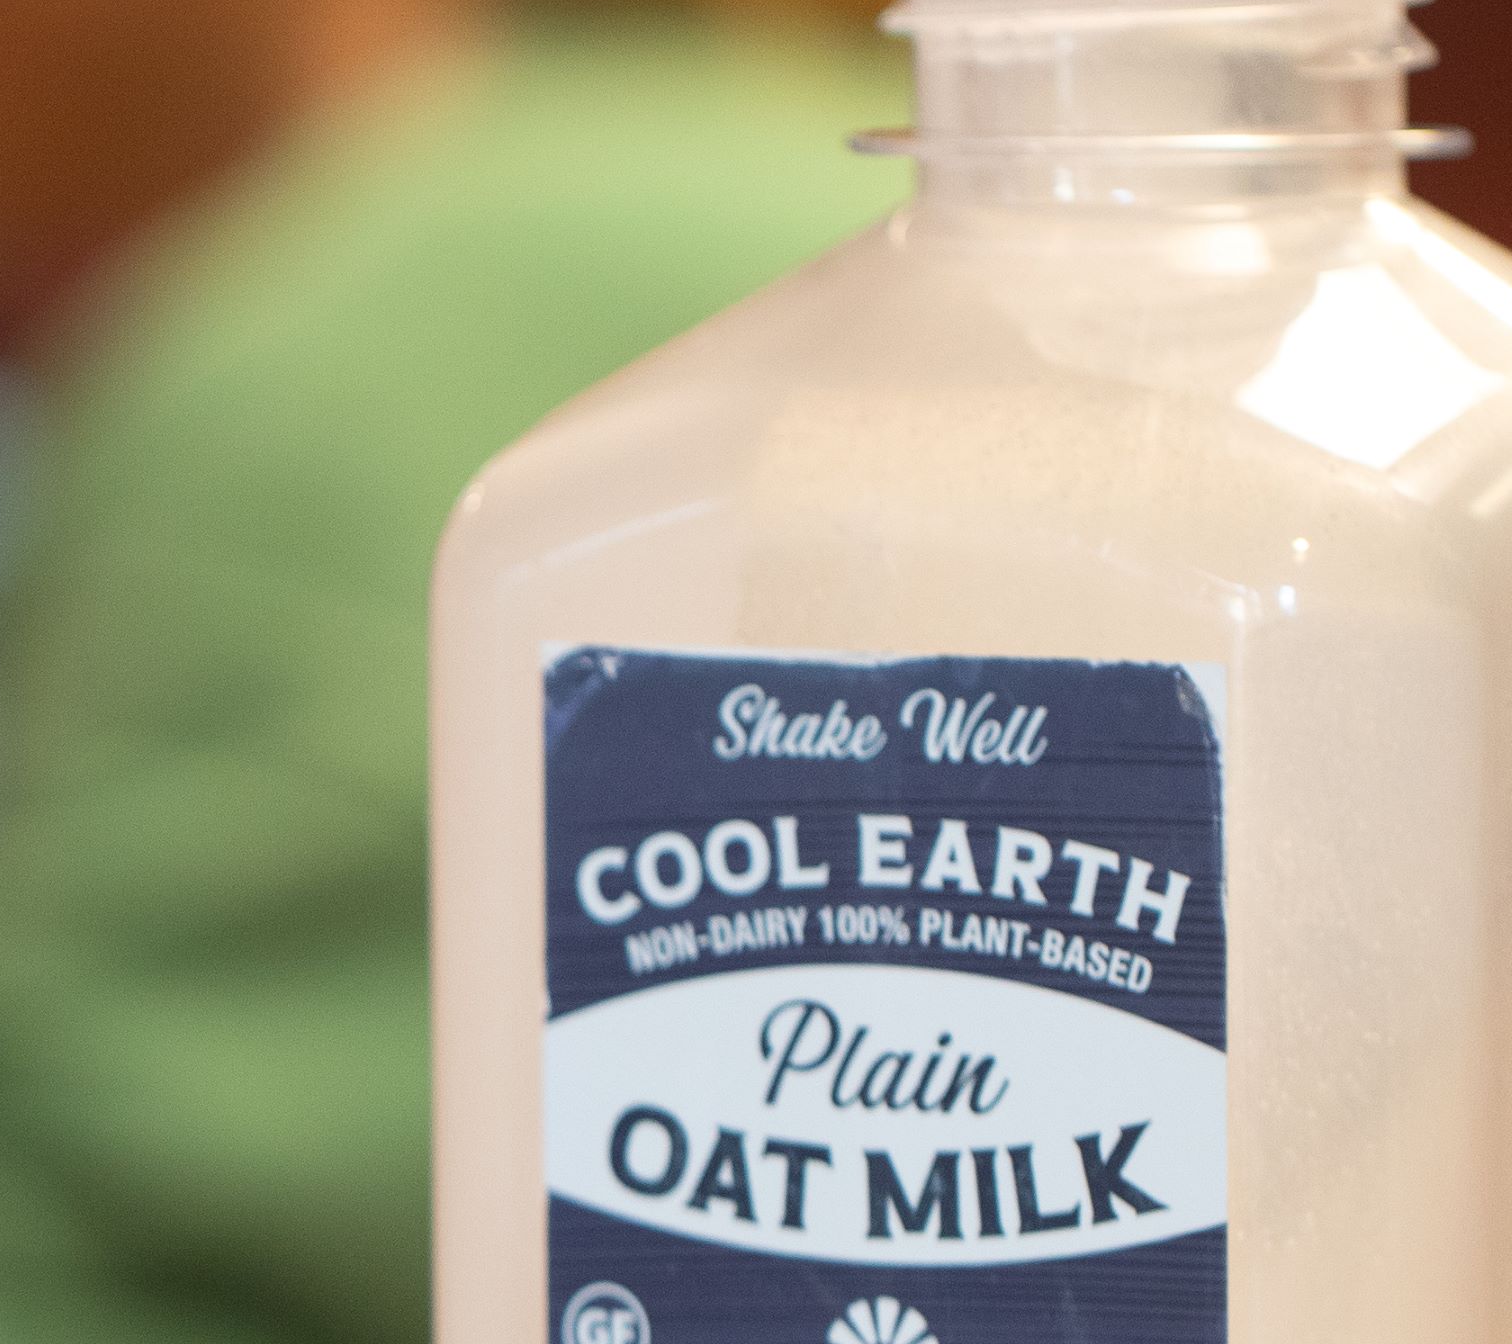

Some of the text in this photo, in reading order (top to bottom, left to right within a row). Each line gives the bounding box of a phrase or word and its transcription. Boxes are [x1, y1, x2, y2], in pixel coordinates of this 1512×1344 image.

[713, 683, 1048, 765] Shake Well
[576, 813, 1191, 945] COOL EARTH
[625, 905, 1153, 994] NON-DAIRY 100% PLANT-BASED
[759, 998, 1010, 1114] Plain
[609, 1102, 1170, 1240] OAT MILK
